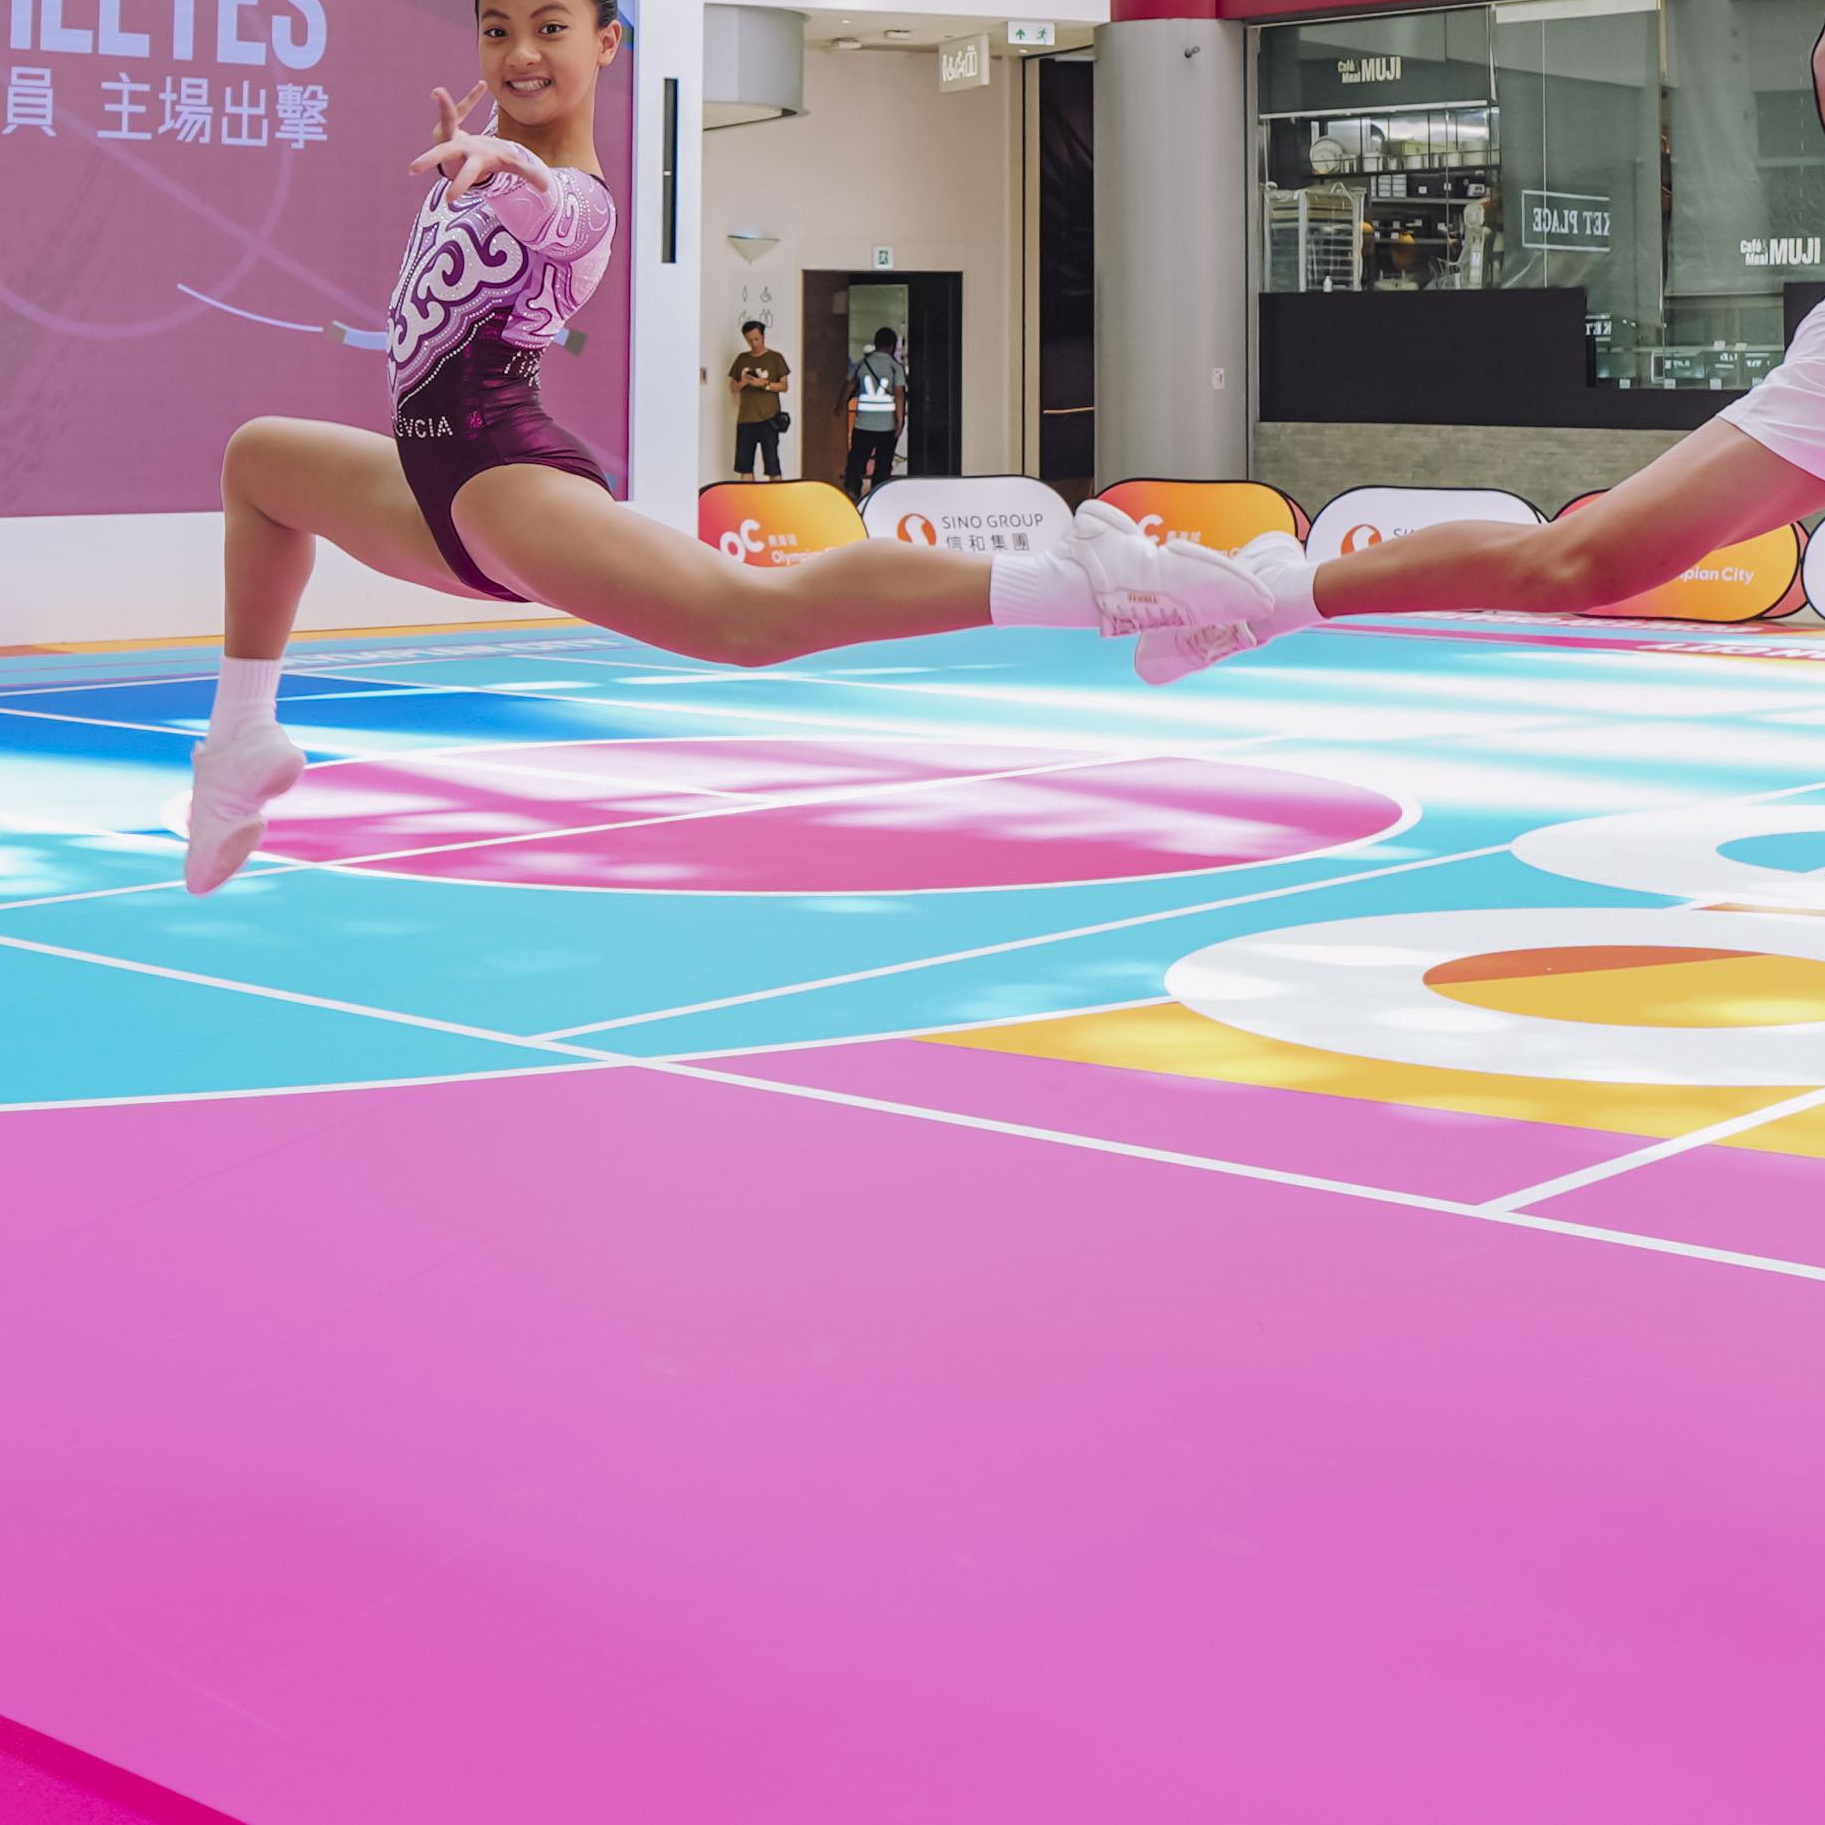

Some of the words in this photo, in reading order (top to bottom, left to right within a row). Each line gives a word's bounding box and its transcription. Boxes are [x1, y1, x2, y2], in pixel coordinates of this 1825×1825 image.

[1361, 56, 1401, 82] MUJI
[97, 72, 329, 150] 主場出擊
[1769, 237, 1822, 265] MUJI
[942, 516, 981, 529] SINO
[986, 514, 1043, 528] GROUP
[946, 533, 1030, 551] 信和集團
[1722, 569, 1755, 585] City
